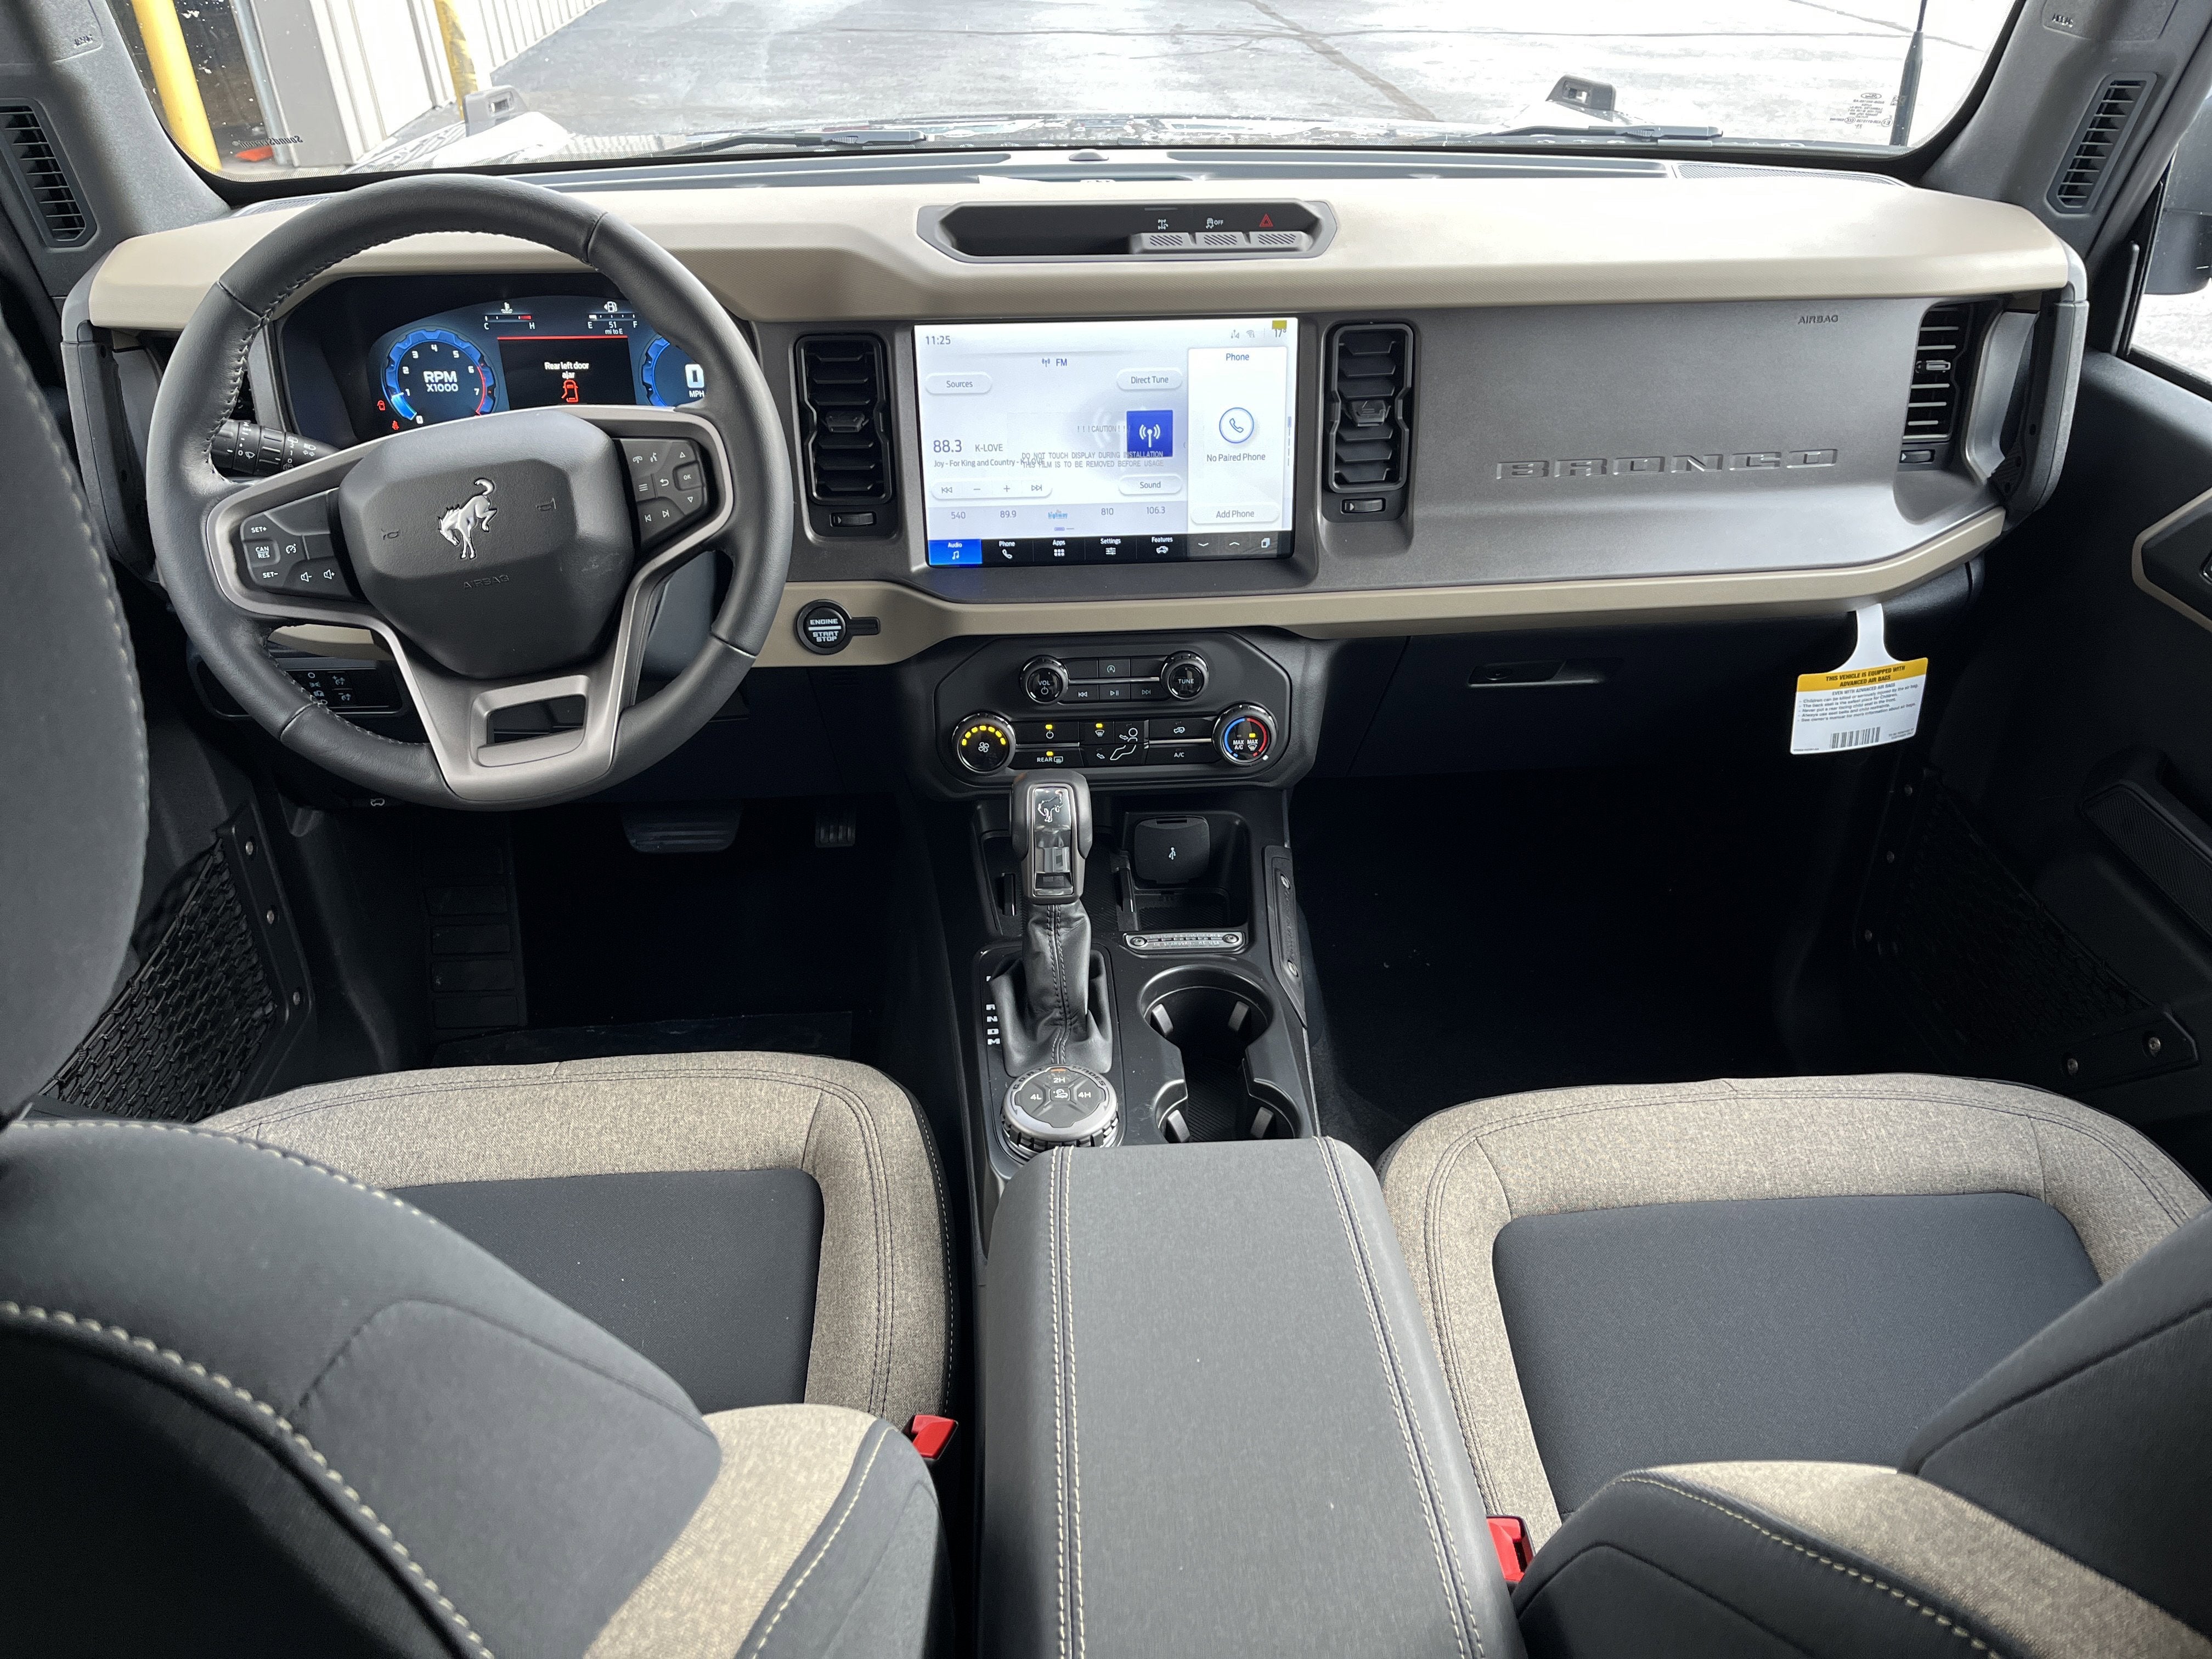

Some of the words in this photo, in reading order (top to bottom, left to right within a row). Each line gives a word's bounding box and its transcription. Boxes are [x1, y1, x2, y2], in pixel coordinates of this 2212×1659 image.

[1798, 314, 1838, 325] AIRBAG
[926, 335, 951, 345] 11:25
[411, 351, 419, 359] 3
[1226, 353, 1250, 361] Phone
[573, 361, 589, 369] door
[1056, 358, 1068, 366] FM
[423, 370, 458, 383] RPM
[562, 371, 575, 380] ajar
[685, 364, 704, 388] 0
[1131, 376, 1150, 384] Direct
[1152, 375, 1169, 383] Tune
[426, 383, 459, 392] X1000
[946, 380, 973, 388] Sources
[416, 415, 424, 424] 0
[933, 439, 962, 453] 88.3
[975, 444, 1003, 452] K-LOVE
[1218, 453, 1241, 461] Paired
[1243, 453, 1266, 461] Phone
[934, 460, 944, 468] Joy
[1496, 449, 1838, 479] BRONCO
[1233, 509, 1254, 517] Phone
[1868, 668, 1892, 676] EQUIPPED
[1073, 1066, 1106, 1086] MODES
